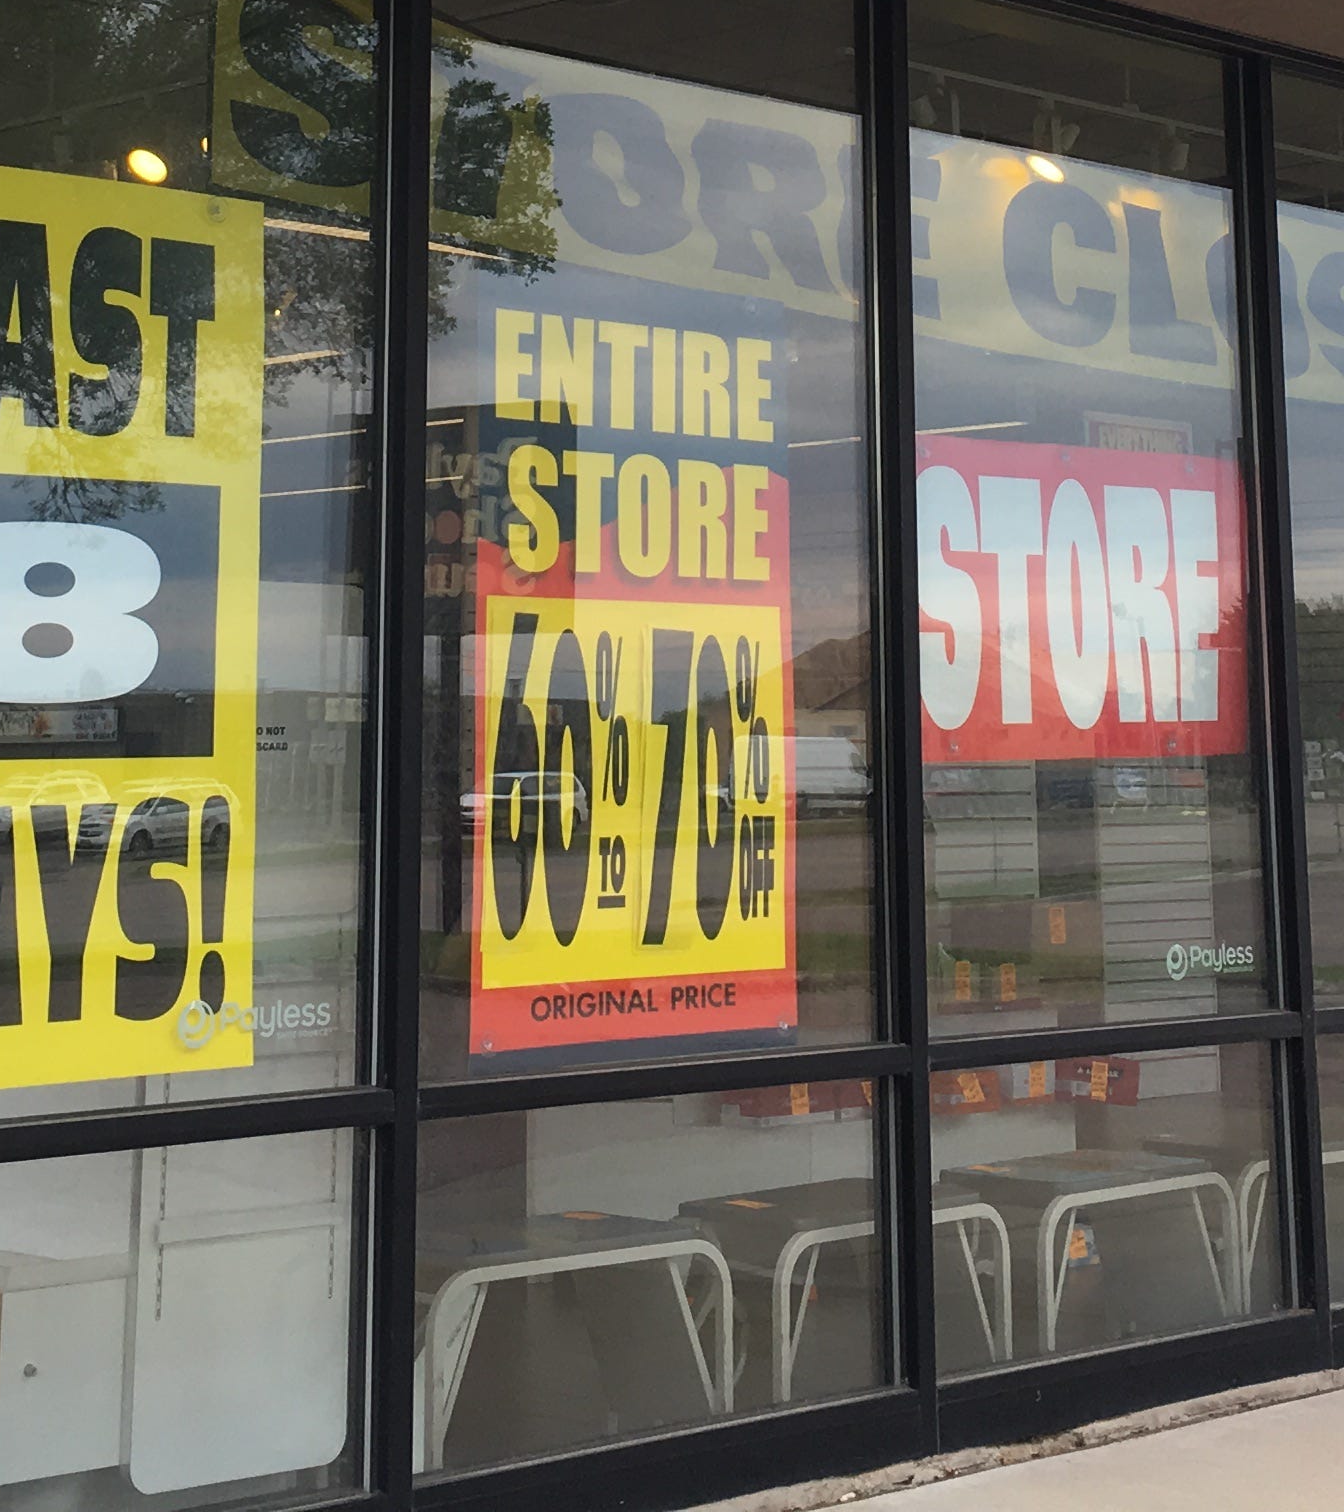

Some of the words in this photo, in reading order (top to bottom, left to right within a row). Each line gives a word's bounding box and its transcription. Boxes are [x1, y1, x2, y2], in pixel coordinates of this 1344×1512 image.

[493, 307, 775, 443] ENTIRE
[507, 452, 771, 582] STORE
[916, 464, 1220, 731] STORE
[265, 727, 286, 736] NOT
[489, 611, 628, 948] 60%
[598, 835, 625, 878] TO
[641, 626, 767, 947] 70%
[738, 813, 775, 922] OFF
[1189, 942, 1254, 972] Payless
[220, 999, 332, 1038] Payless
[530, 987, 659, 1022] ORIGINAL
[670, 981, 737, 1011] PRICE
